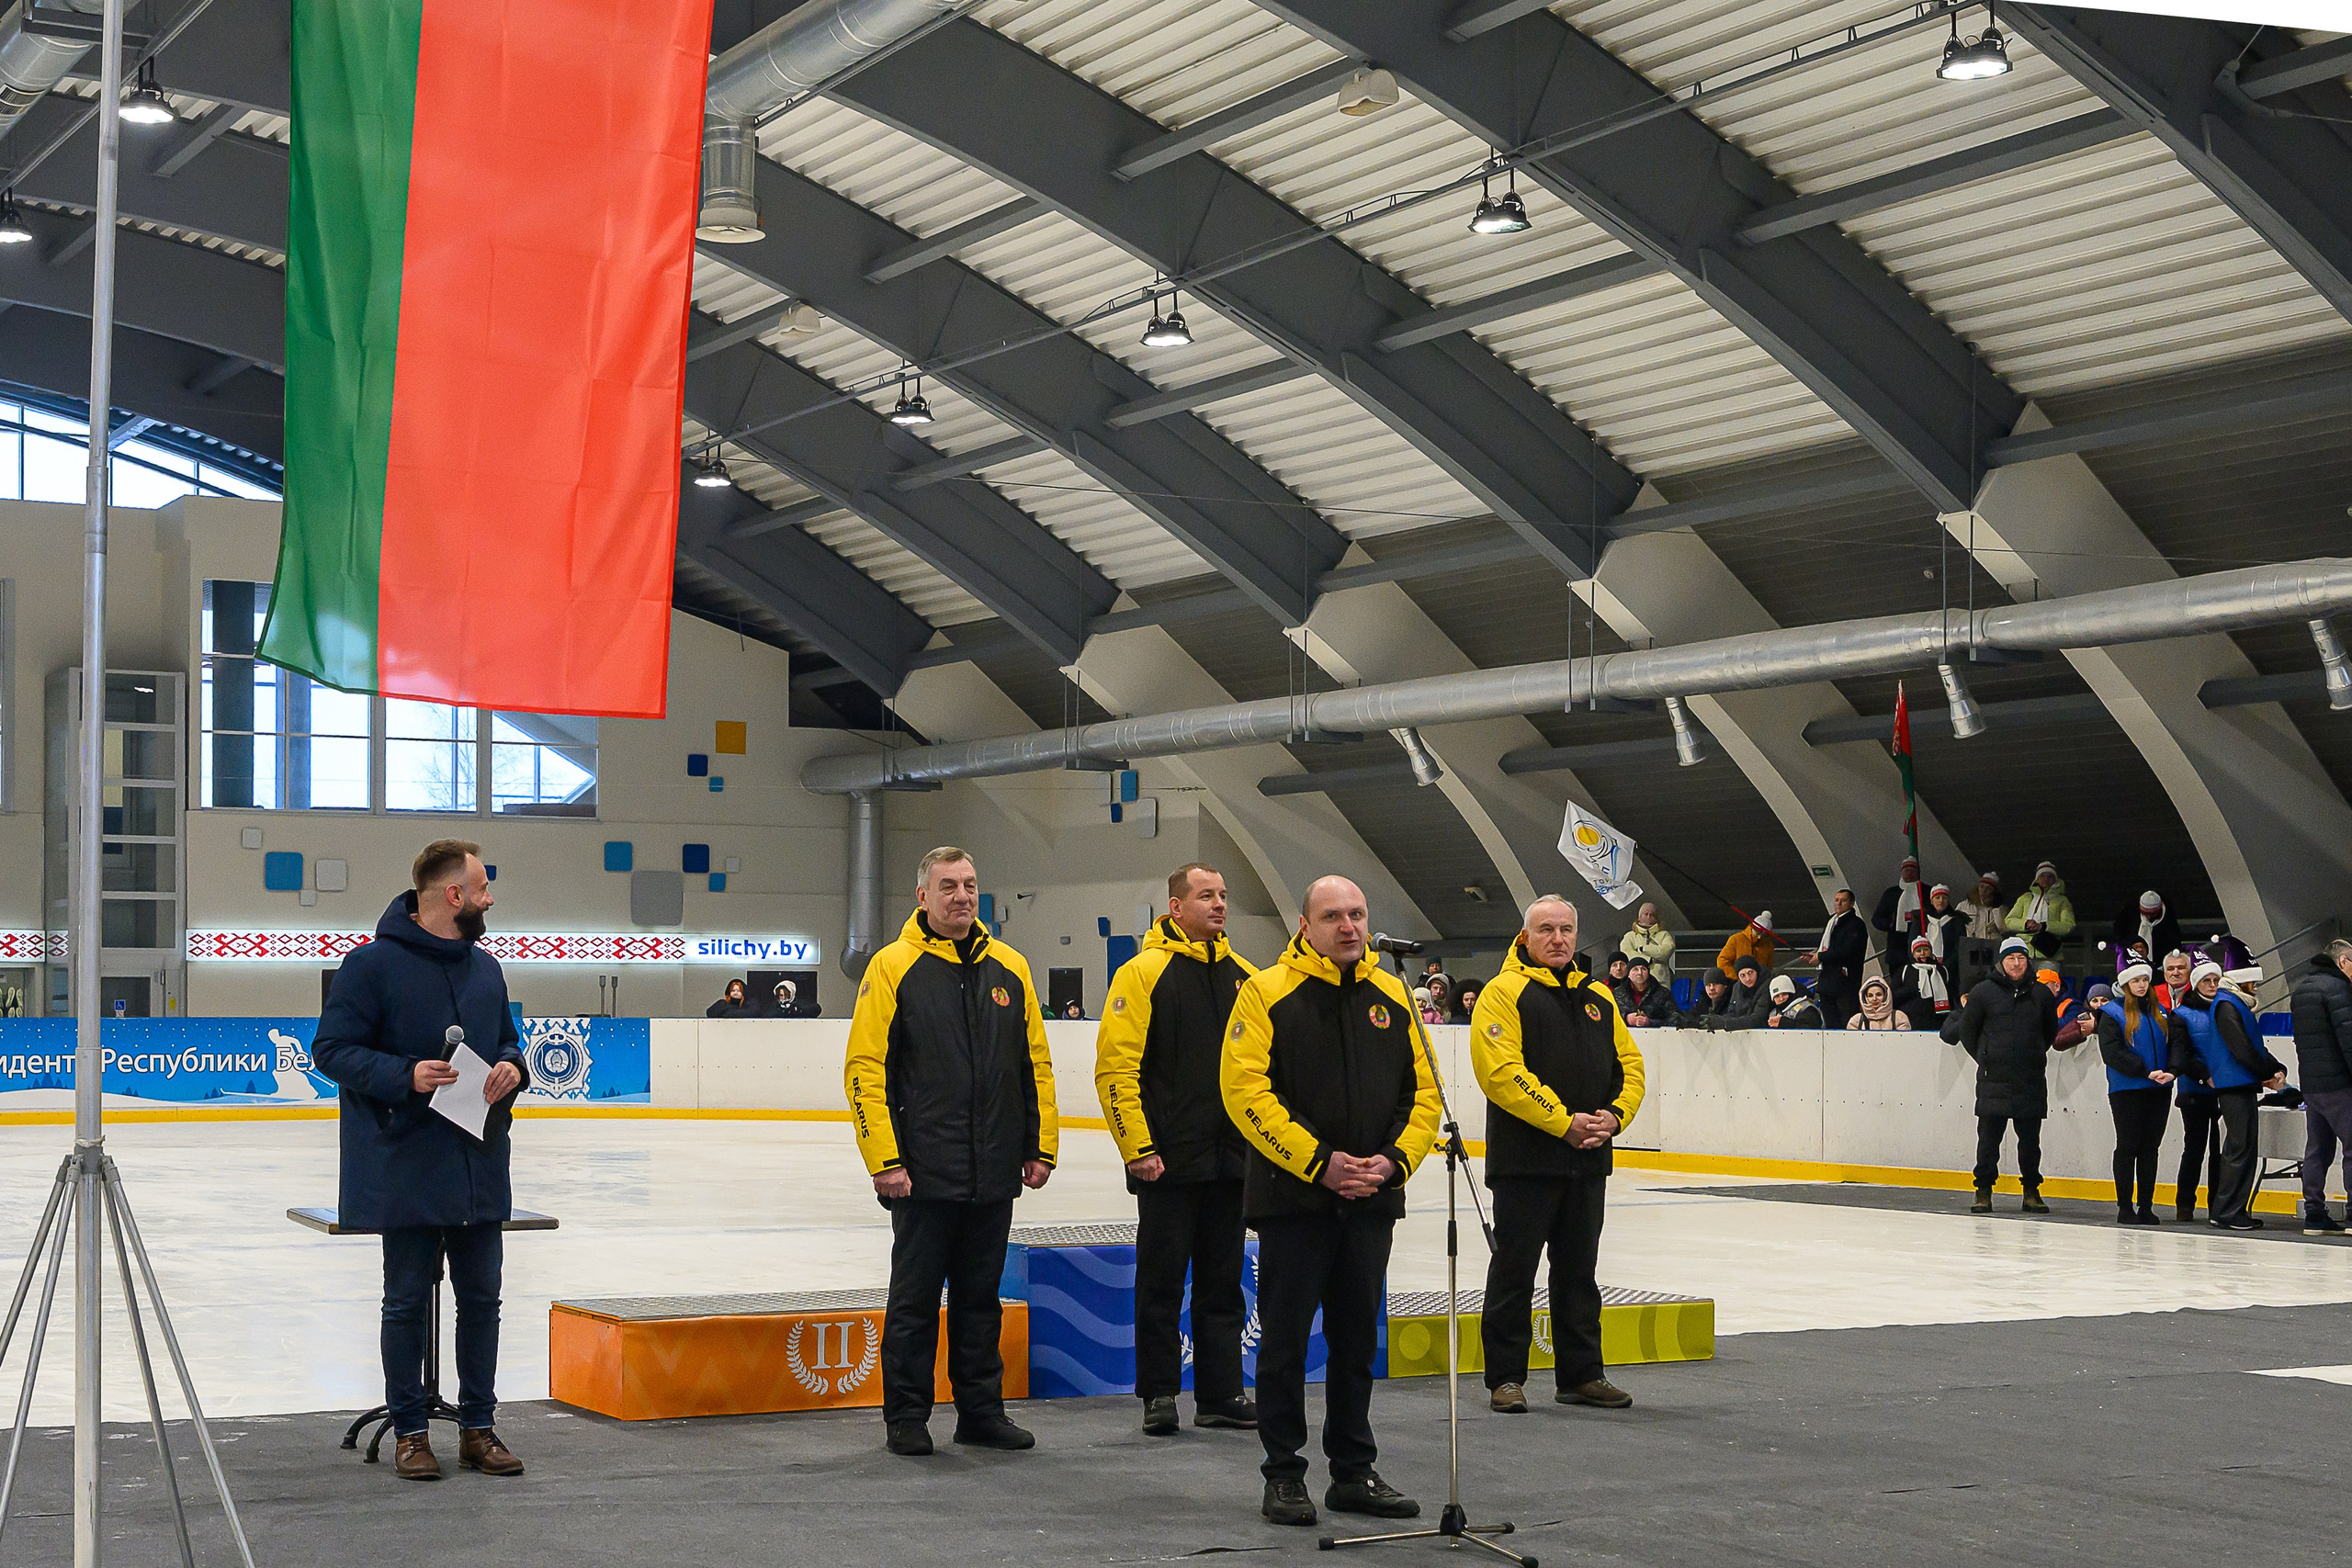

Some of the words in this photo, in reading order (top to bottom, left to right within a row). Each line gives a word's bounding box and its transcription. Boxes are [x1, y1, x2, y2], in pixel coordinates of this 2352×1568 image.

[698, 939, 808, 959] silichy.by
[101, 1046, 267, 1079] Республики
[853, 1077, 870, 1139] BELARUS
[1109, 1084, 1127, 1138] BELARUS
[1513, 1074, 1555, 1113] BELARUS
[1245, 1107, 1293, 1161] BELARUS
[811, 1321, 855, 1370] II
